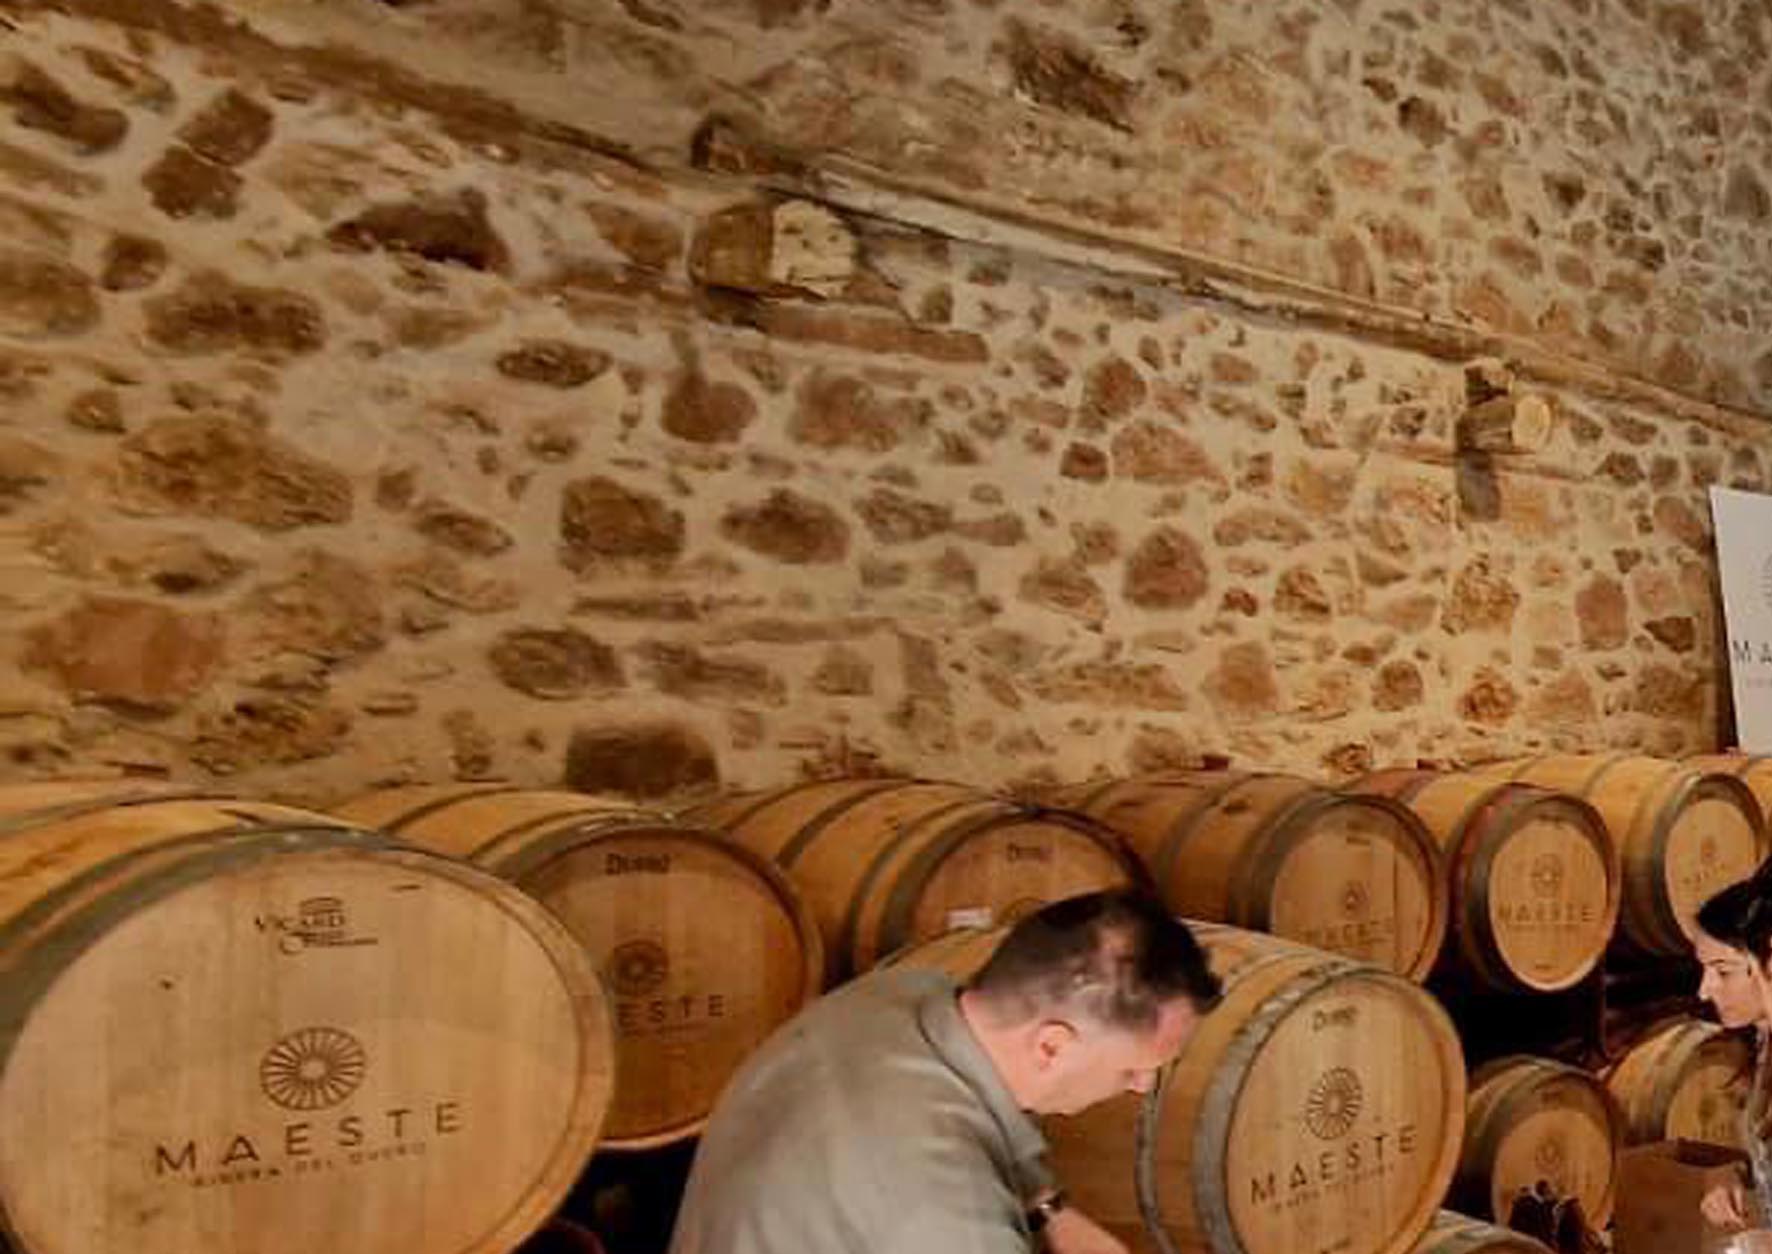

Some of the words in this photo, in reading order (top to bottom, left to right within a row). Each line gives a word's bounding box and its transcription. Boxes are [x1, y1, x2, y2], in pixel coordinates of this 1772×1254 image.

[617, 994, 725, 1029] ESTE
[155, 1102, 462, 1177] MAESTE
[1250, 1125, 1419, 1205] MAESTE
